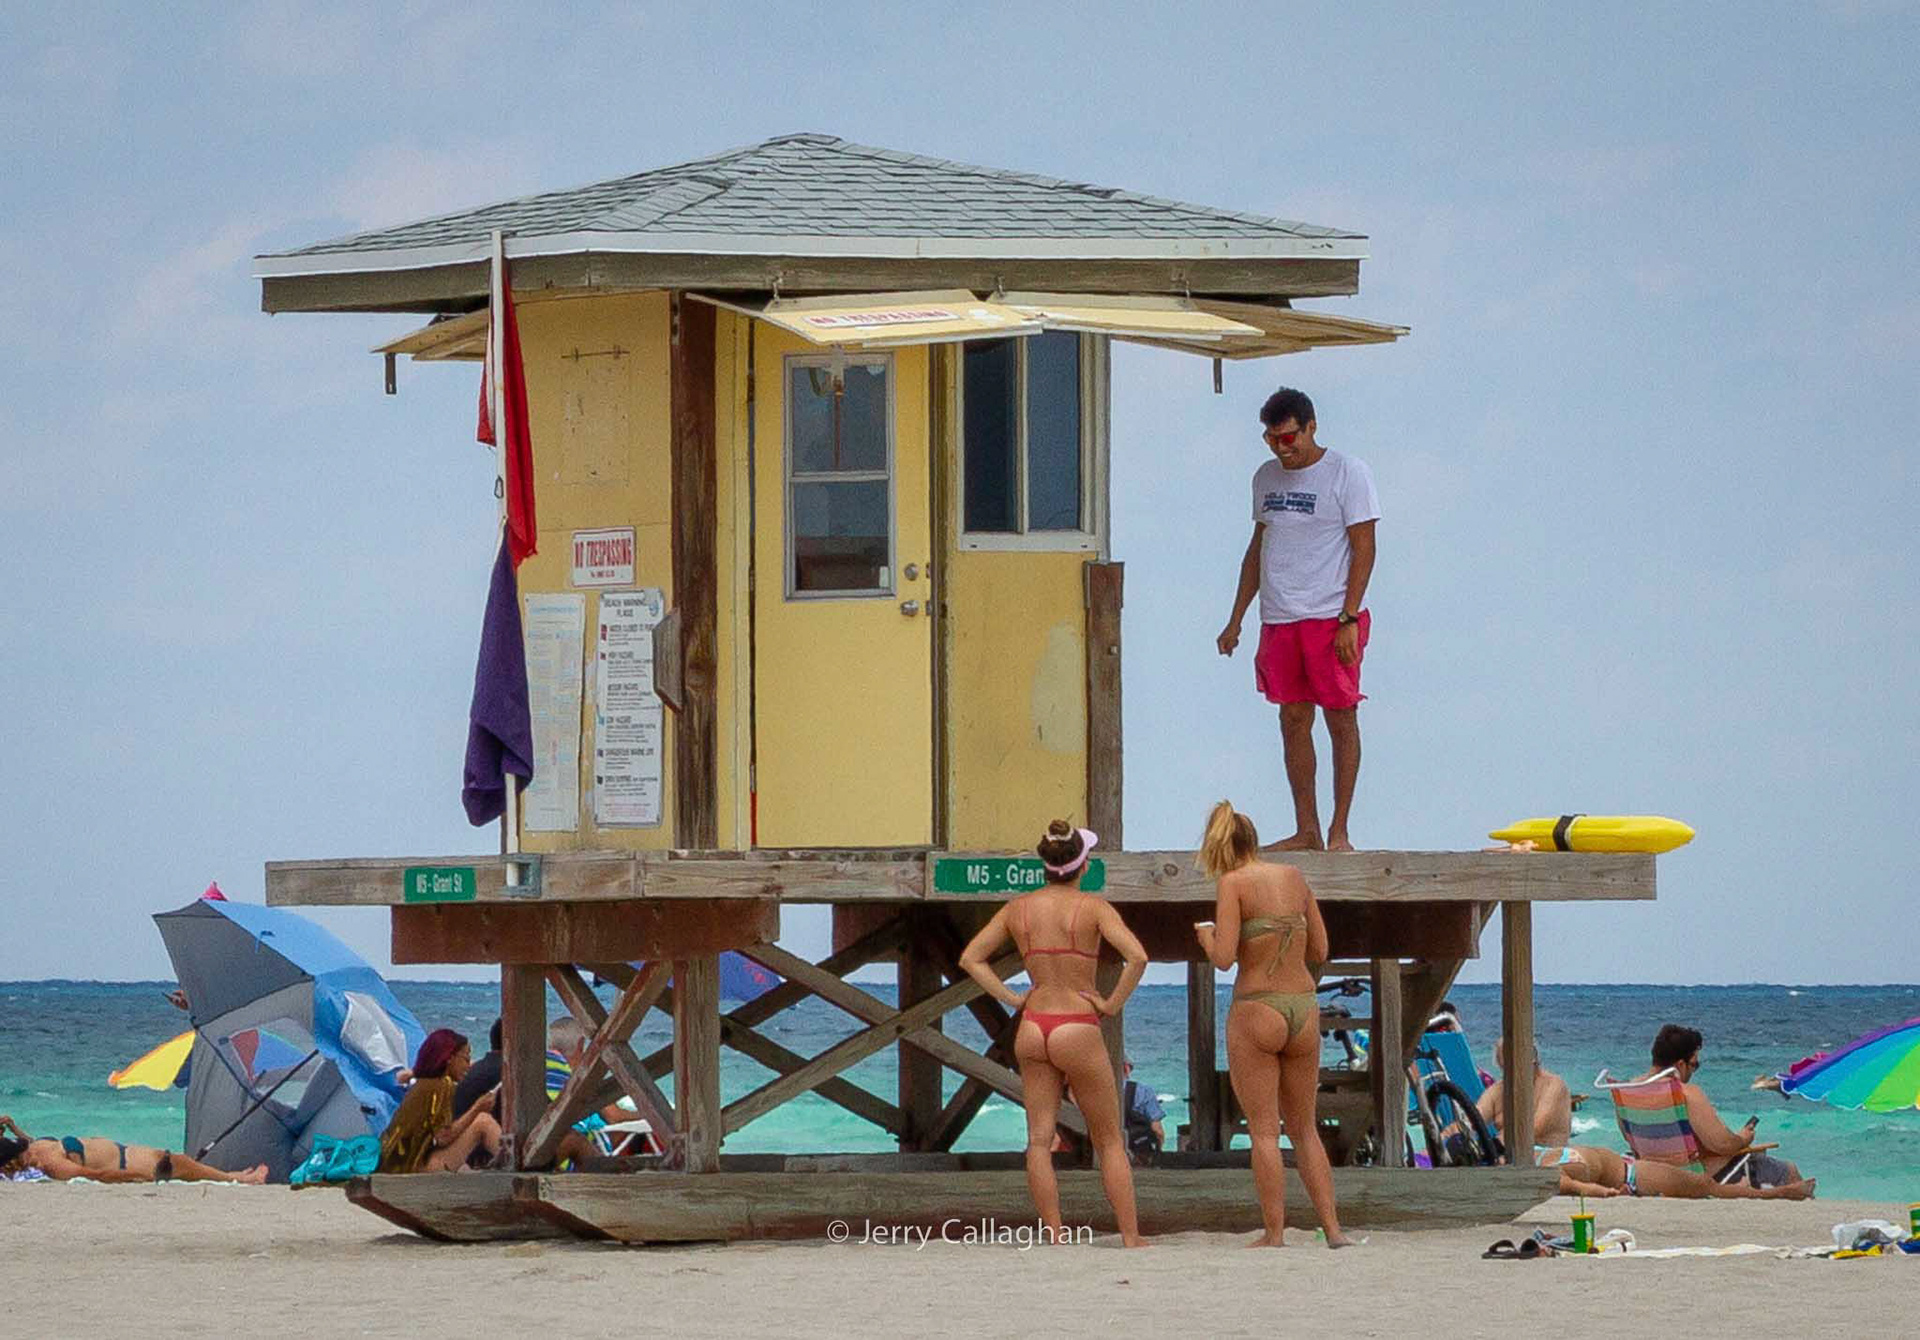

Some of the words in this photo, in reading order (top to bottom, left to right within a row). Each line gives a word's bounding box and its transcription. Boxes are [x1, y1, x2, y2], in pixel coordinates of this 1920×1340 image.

[575, 541, 583, 568] NO
[586, 538, 631, 567] TRESPASSING
[967, 865, 990, 885] M5
[1006, 864, 1045, 885] Gran
